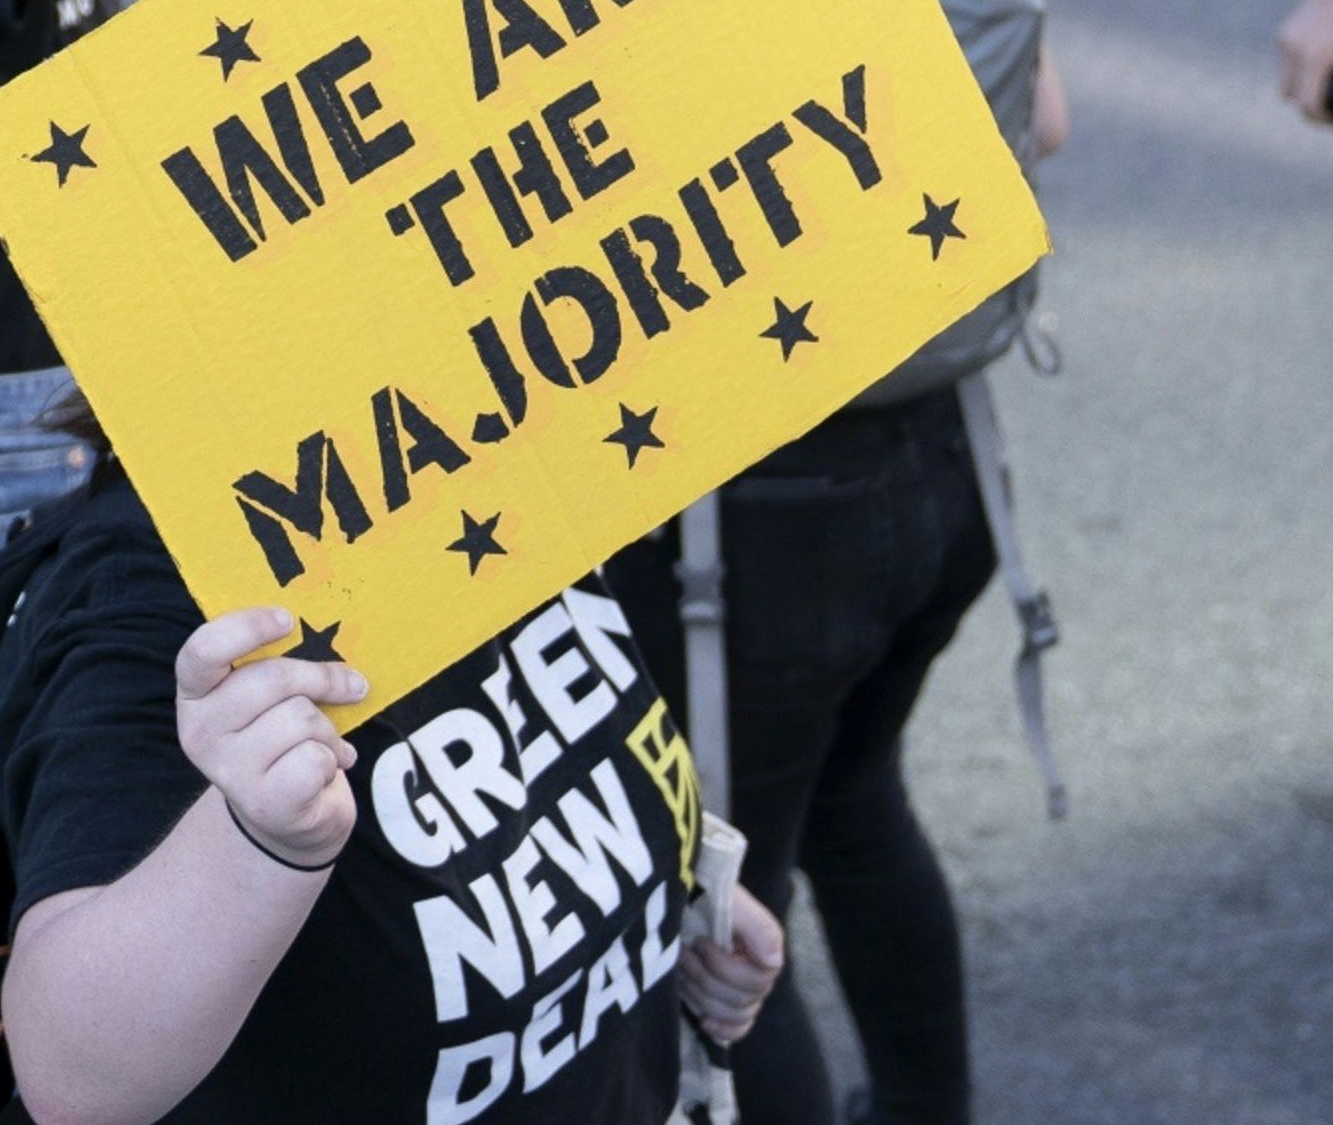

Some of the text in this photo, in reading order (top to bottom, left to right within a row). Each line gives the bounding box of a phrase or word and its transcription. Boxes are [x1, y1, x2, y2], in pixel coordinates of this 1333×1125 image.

[160, 35, 415, 263] WE
[384, 79, 636, 287] THE
[231, 63, 884, 588] MAJORITY
[371, 586, 639, 868] GREEN
[413, 757, 654, 1023] NEW
[426, 880, 681, 1125] DEAL
